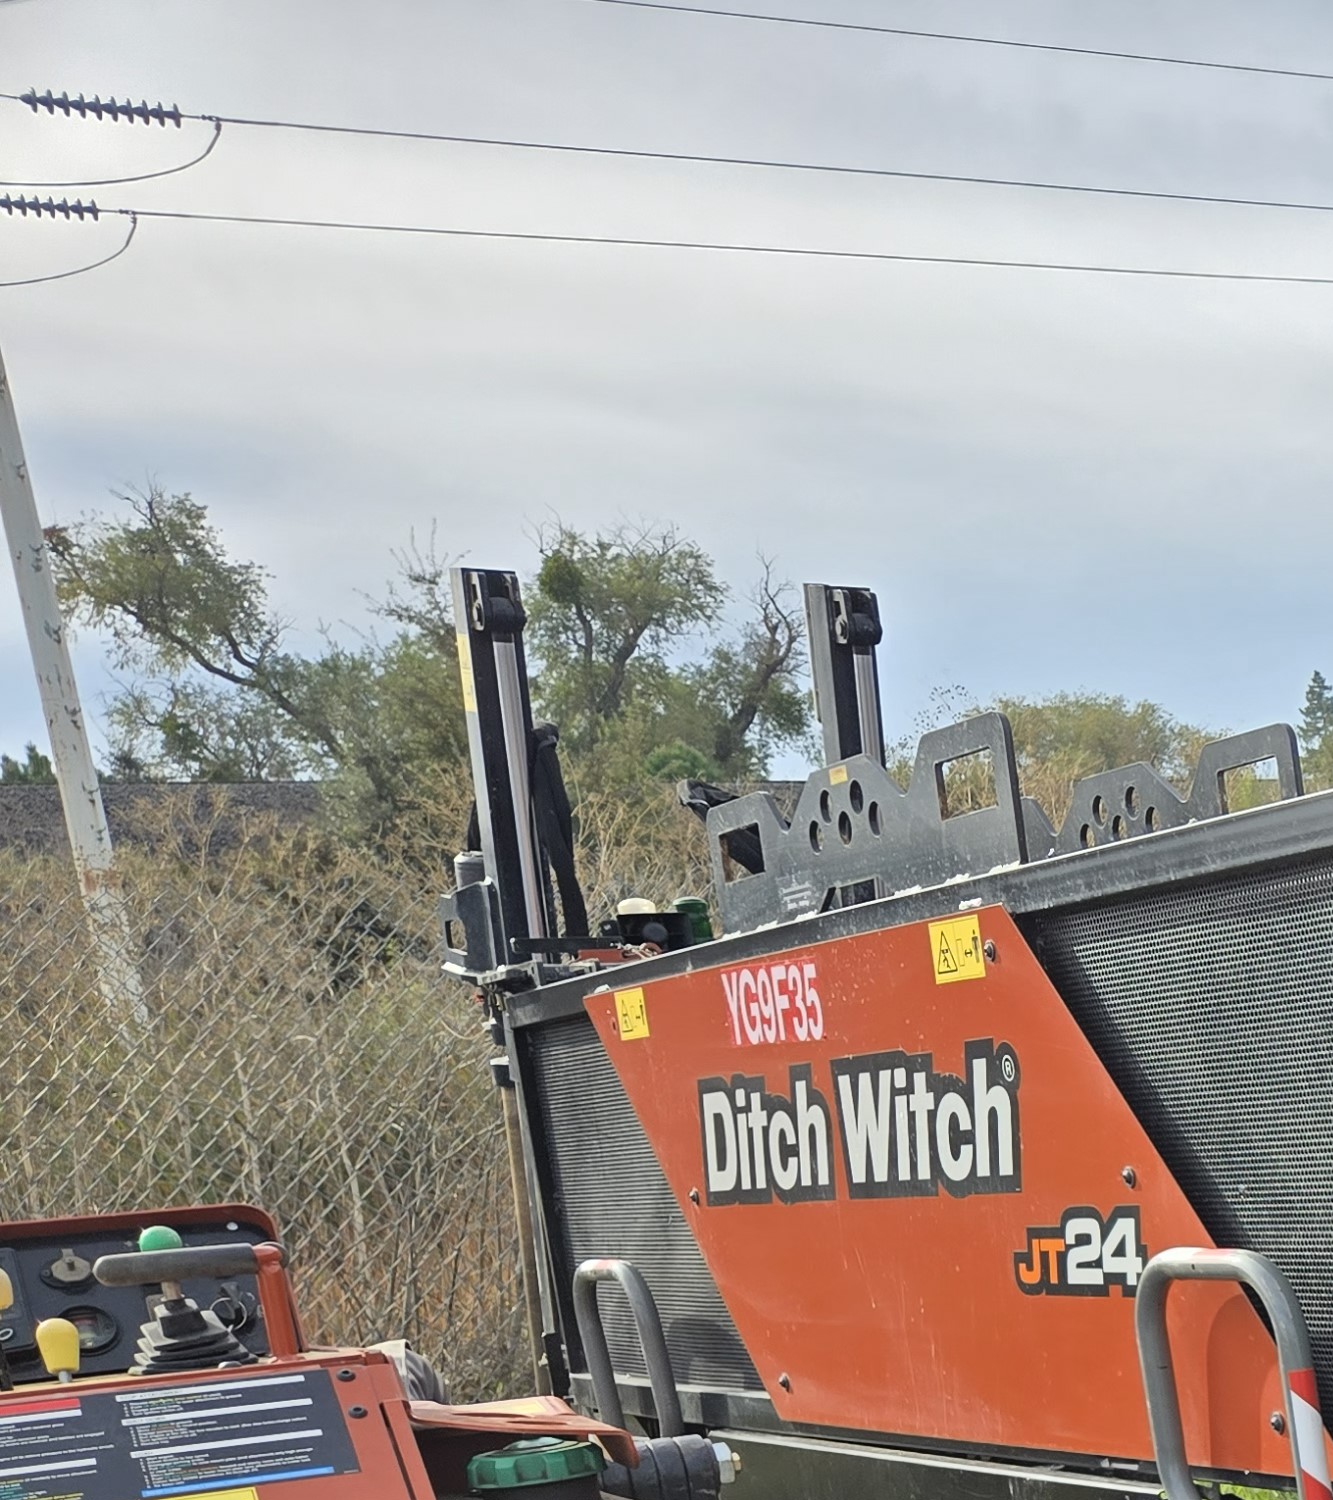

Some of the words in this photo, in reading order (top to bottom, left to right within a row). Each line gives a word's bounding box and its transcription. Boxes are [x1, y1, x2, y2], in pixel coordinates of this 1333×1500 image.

[721, 962, 824, 1046] YG9F35
[702, 1080, 831, 1193] Ditch
[1018, 1217, 1143, 1286] JT24
